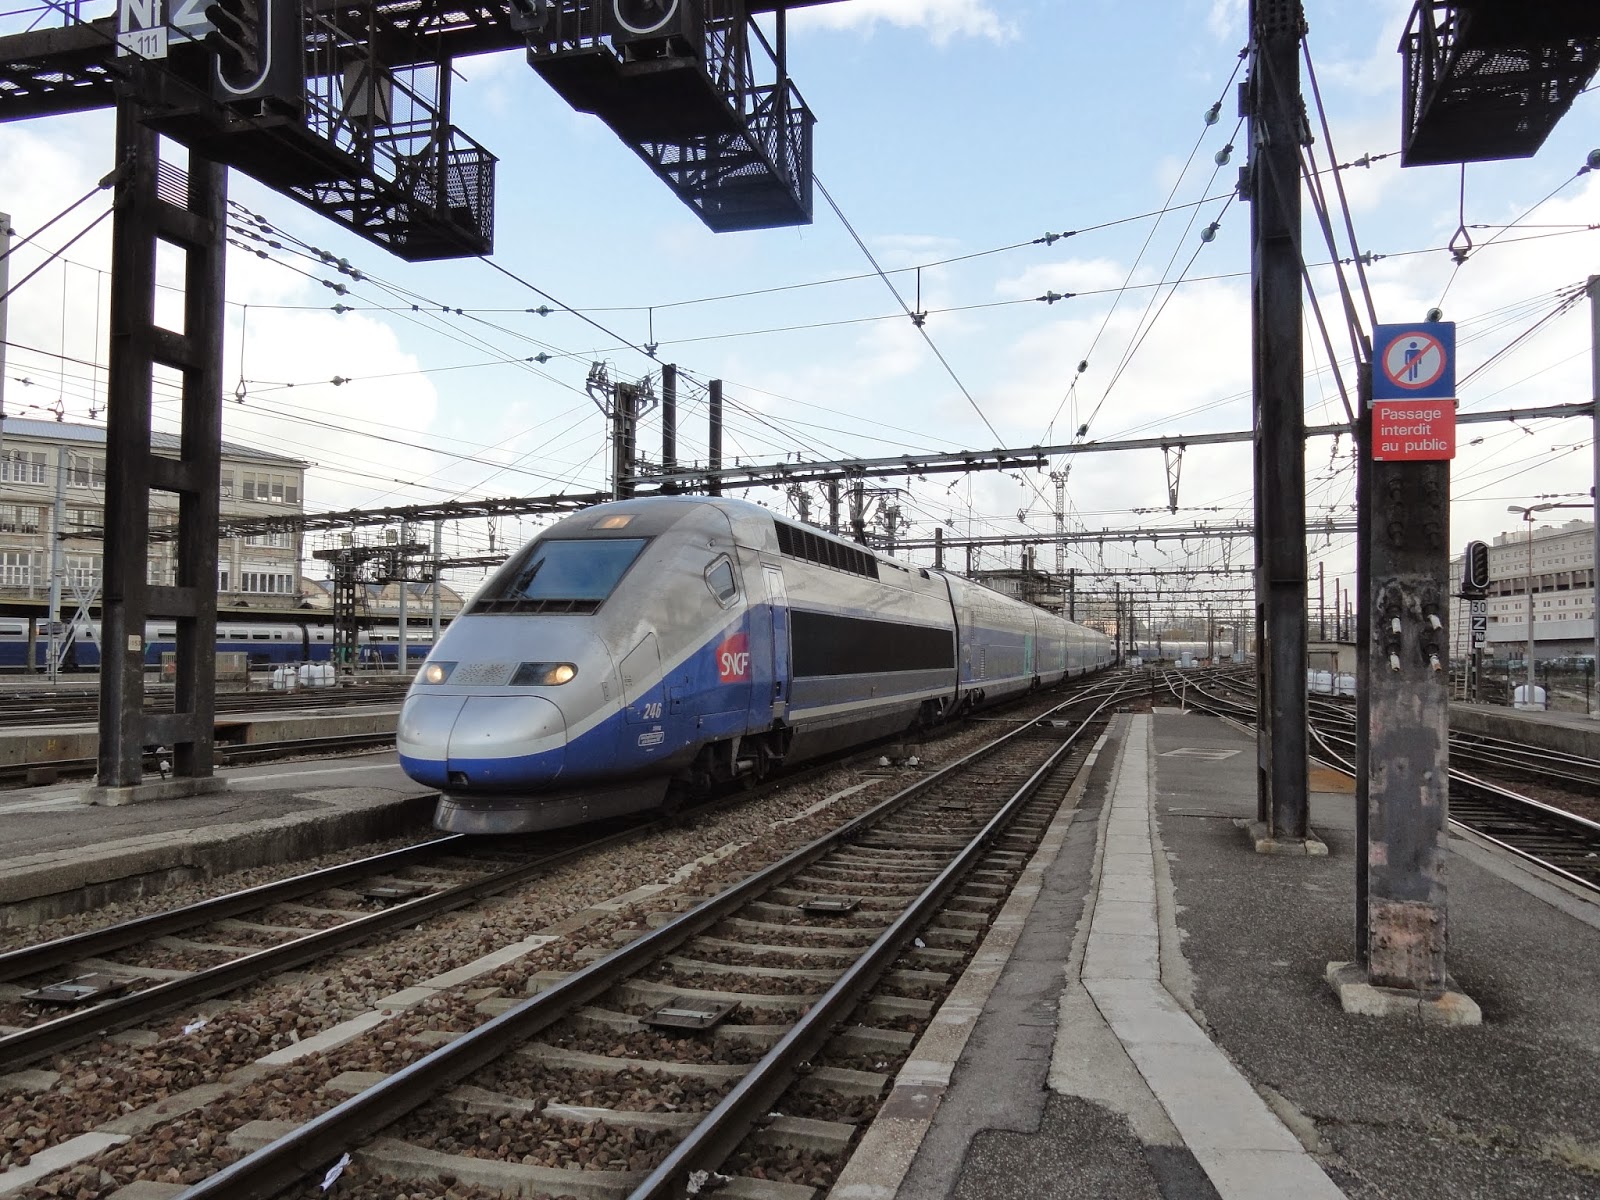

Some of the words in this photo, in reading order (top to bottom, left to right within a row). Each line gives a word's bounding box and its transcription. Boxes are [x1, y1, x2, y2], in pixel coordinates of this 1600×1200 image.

[1381, 408, 1442, 422] Passage
[1381, 423, 1432, 436] interdit
[1381, 442, 1399, 452] au
[1405, 438, 1448, 454] public
[1472, 601, 1486, 613] 30
[1473, 617, 1486, 630] Z
[721, 652, 750, 676] SNCF
[643, 702, 662, 719] 246
